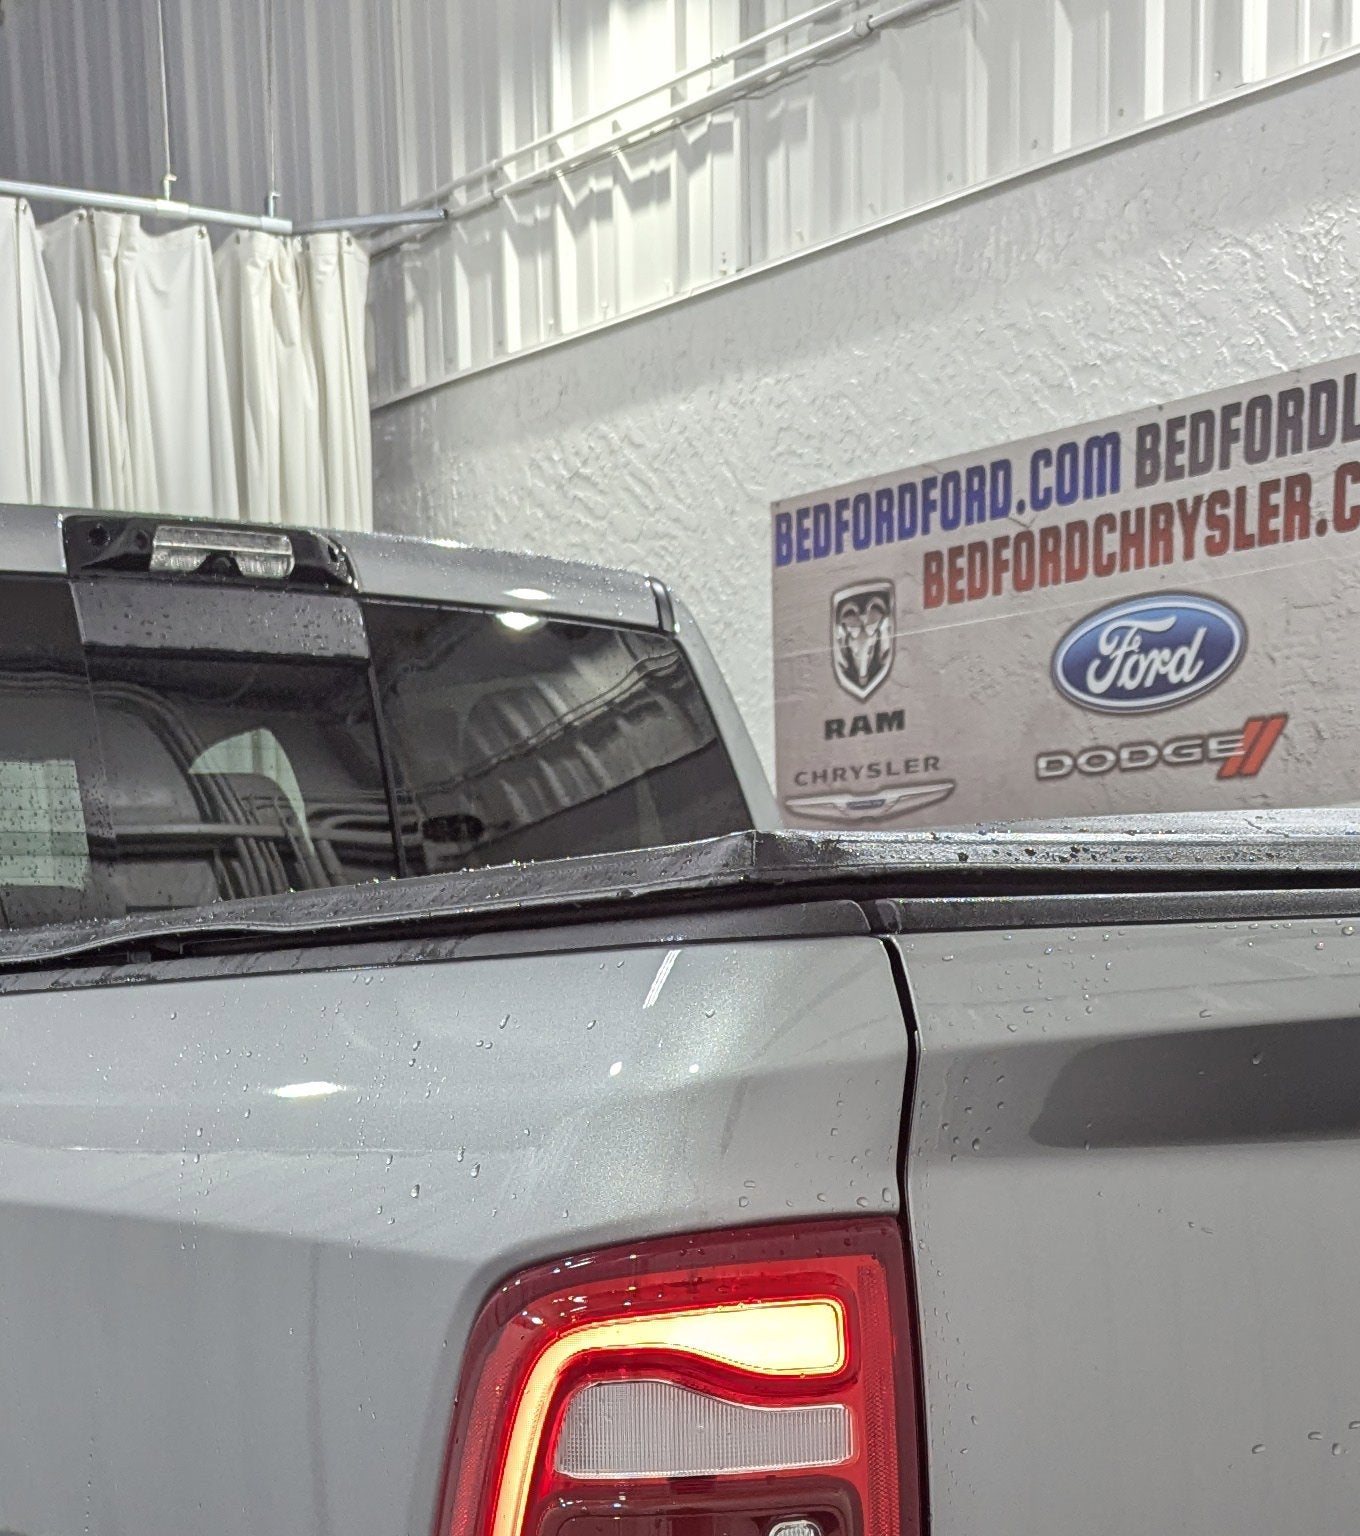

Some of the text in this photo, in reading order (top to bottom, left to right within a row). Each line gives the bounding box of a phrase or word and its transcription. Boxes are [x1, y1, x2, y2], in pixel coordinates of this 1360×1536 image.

[774, 430, 1122, 568] BEDFORDFORD.COM
[1086, 614, 1208, 695] Ford
[824, 708, 906, 741] RAM
[793, 756, 941, 787] CHRYSLER
[1035, 730, 1248, 781] DODGE
